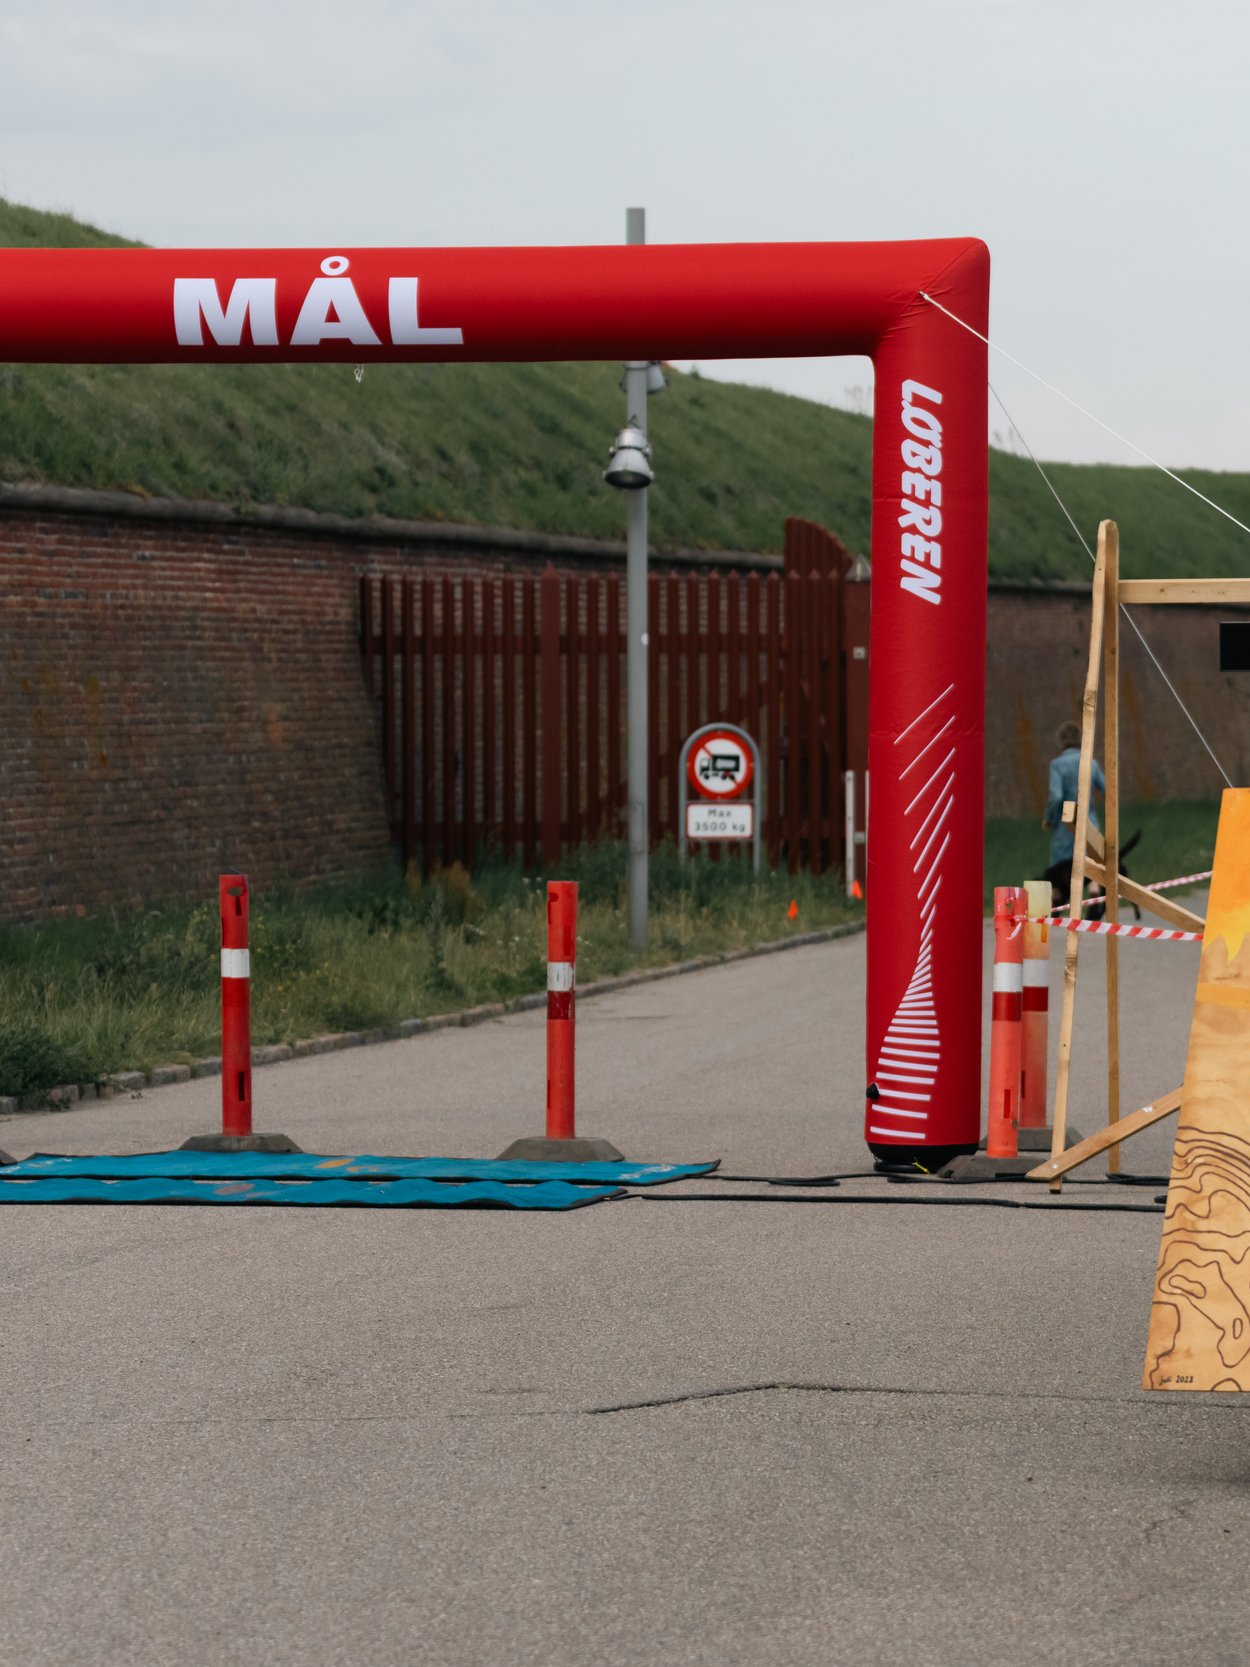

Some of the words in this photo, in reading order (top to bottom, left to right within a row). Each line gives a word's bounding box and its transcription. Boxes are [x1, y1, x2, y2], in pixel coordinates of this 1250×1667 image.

[173, 255, 464, 346] MÅL
[897, 379, 943, 605] LØBEREN
[695, 821, 727, 832] 3500
[732, 822, 746, 833] kg
[707, 808, 732, 818] Max
